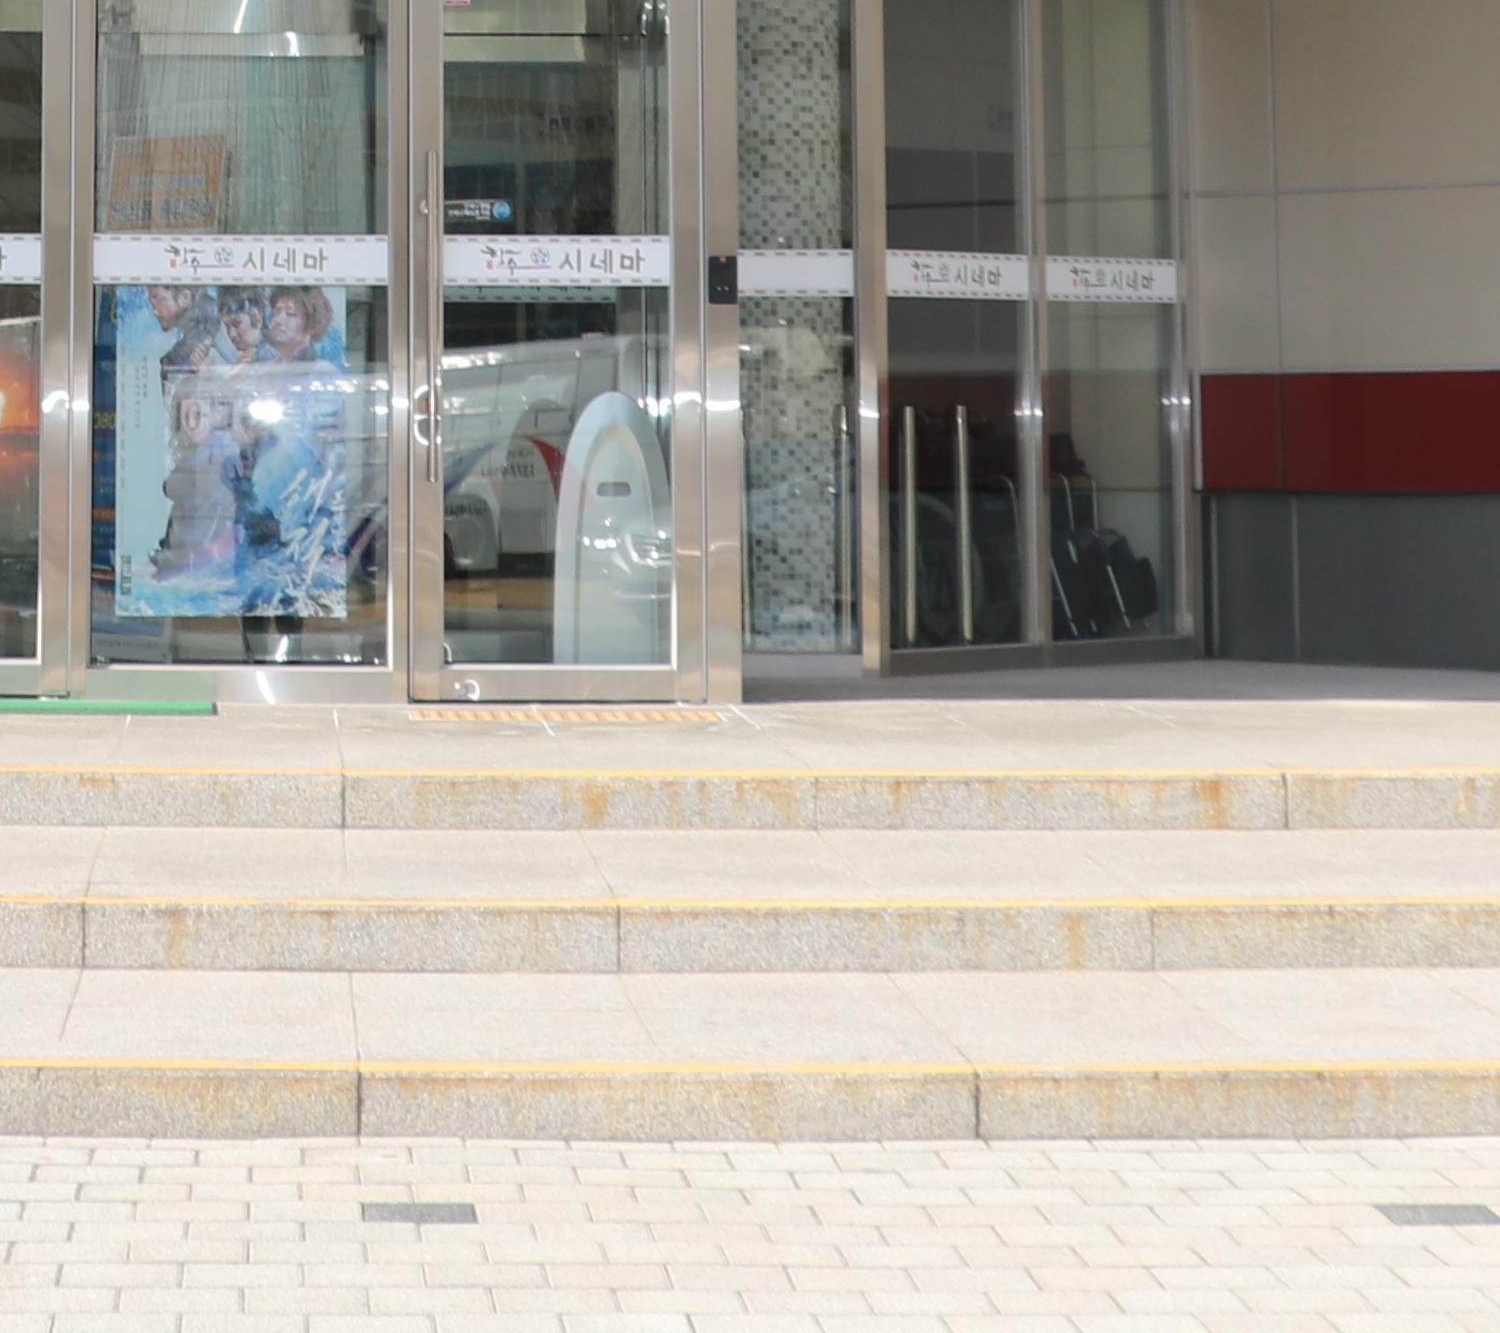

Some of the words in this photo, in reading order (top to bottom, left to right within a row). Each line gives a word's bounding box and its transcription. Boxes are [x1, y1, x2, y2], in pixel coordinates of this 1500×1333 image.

[242, 247, 329, 272] 시네마
[559, 248, 646, 274] 시네마
[955, 263, 1002, 288] 시네마
[1111, 269, 1154, 292] 시네마
